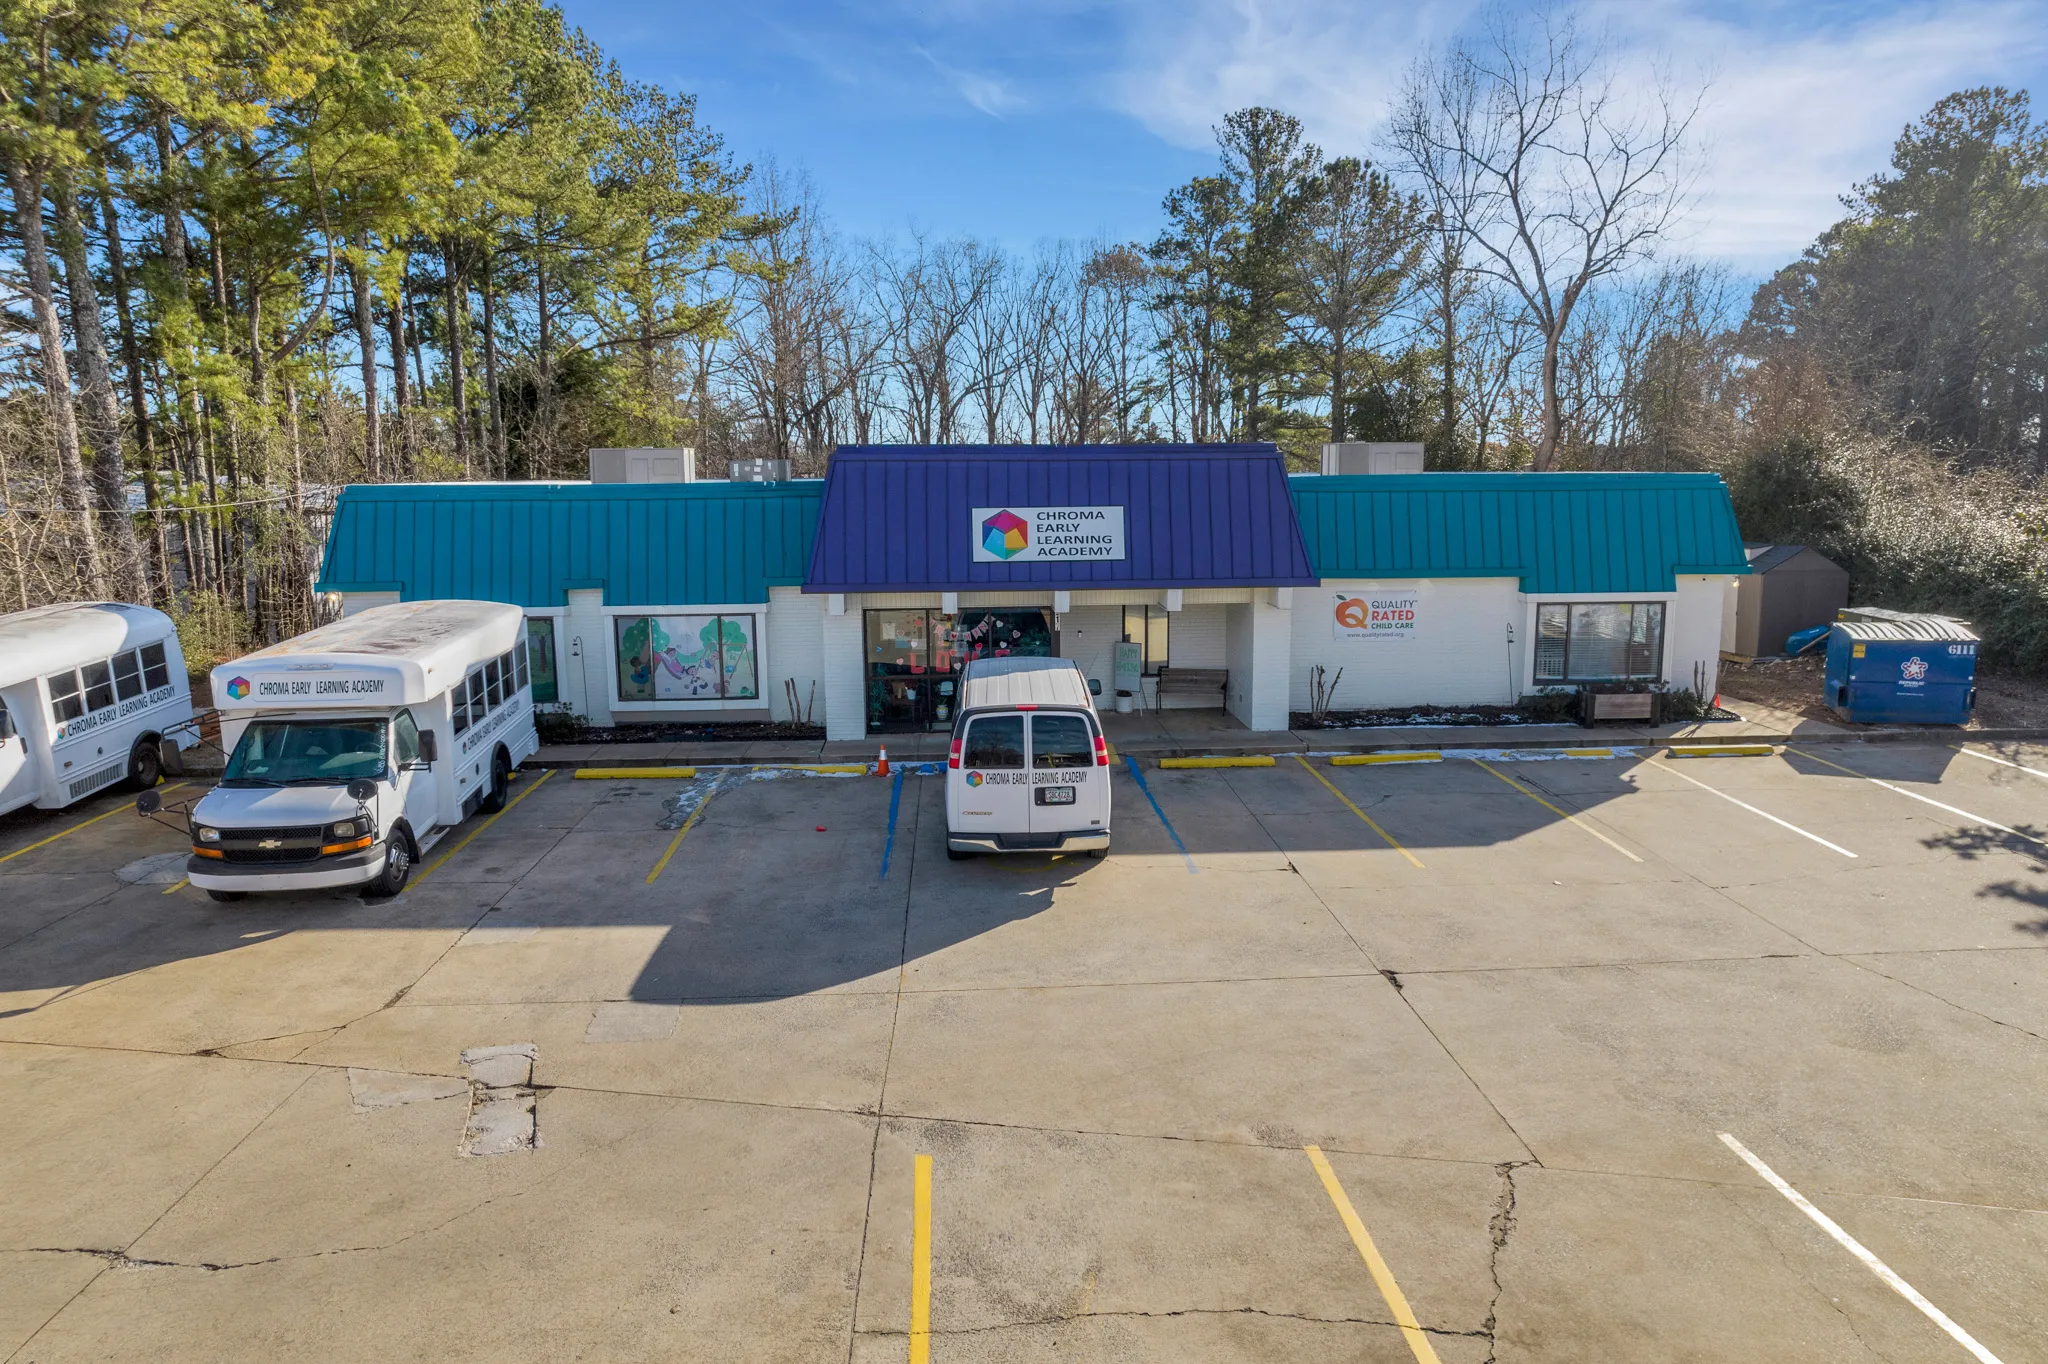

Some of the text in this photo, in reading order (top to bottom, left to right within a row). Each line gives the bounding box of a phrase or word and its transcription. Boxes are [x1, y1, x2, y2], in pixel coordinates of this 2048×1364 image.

[1036, 511, 1105, 521] CHROMA
[1036, 523, 1080, 533] EARLY
[1037, 535, 1112, 545] LEARNING
[1037, 546, 1113, 556] ACADEMY
[1371, 609, 1415, 621] RATED
[1948, 644, 1975, 655] 6111
[259, 679, 385, 696] CHROMA EARLY LEARNING ACADEMY
[67, 684, 176, 737] CHROMA EARLY LEARNING ACADEMY
[985, 770, 1088, 785] CHROMA EARLY LEARNING ACADEMY
